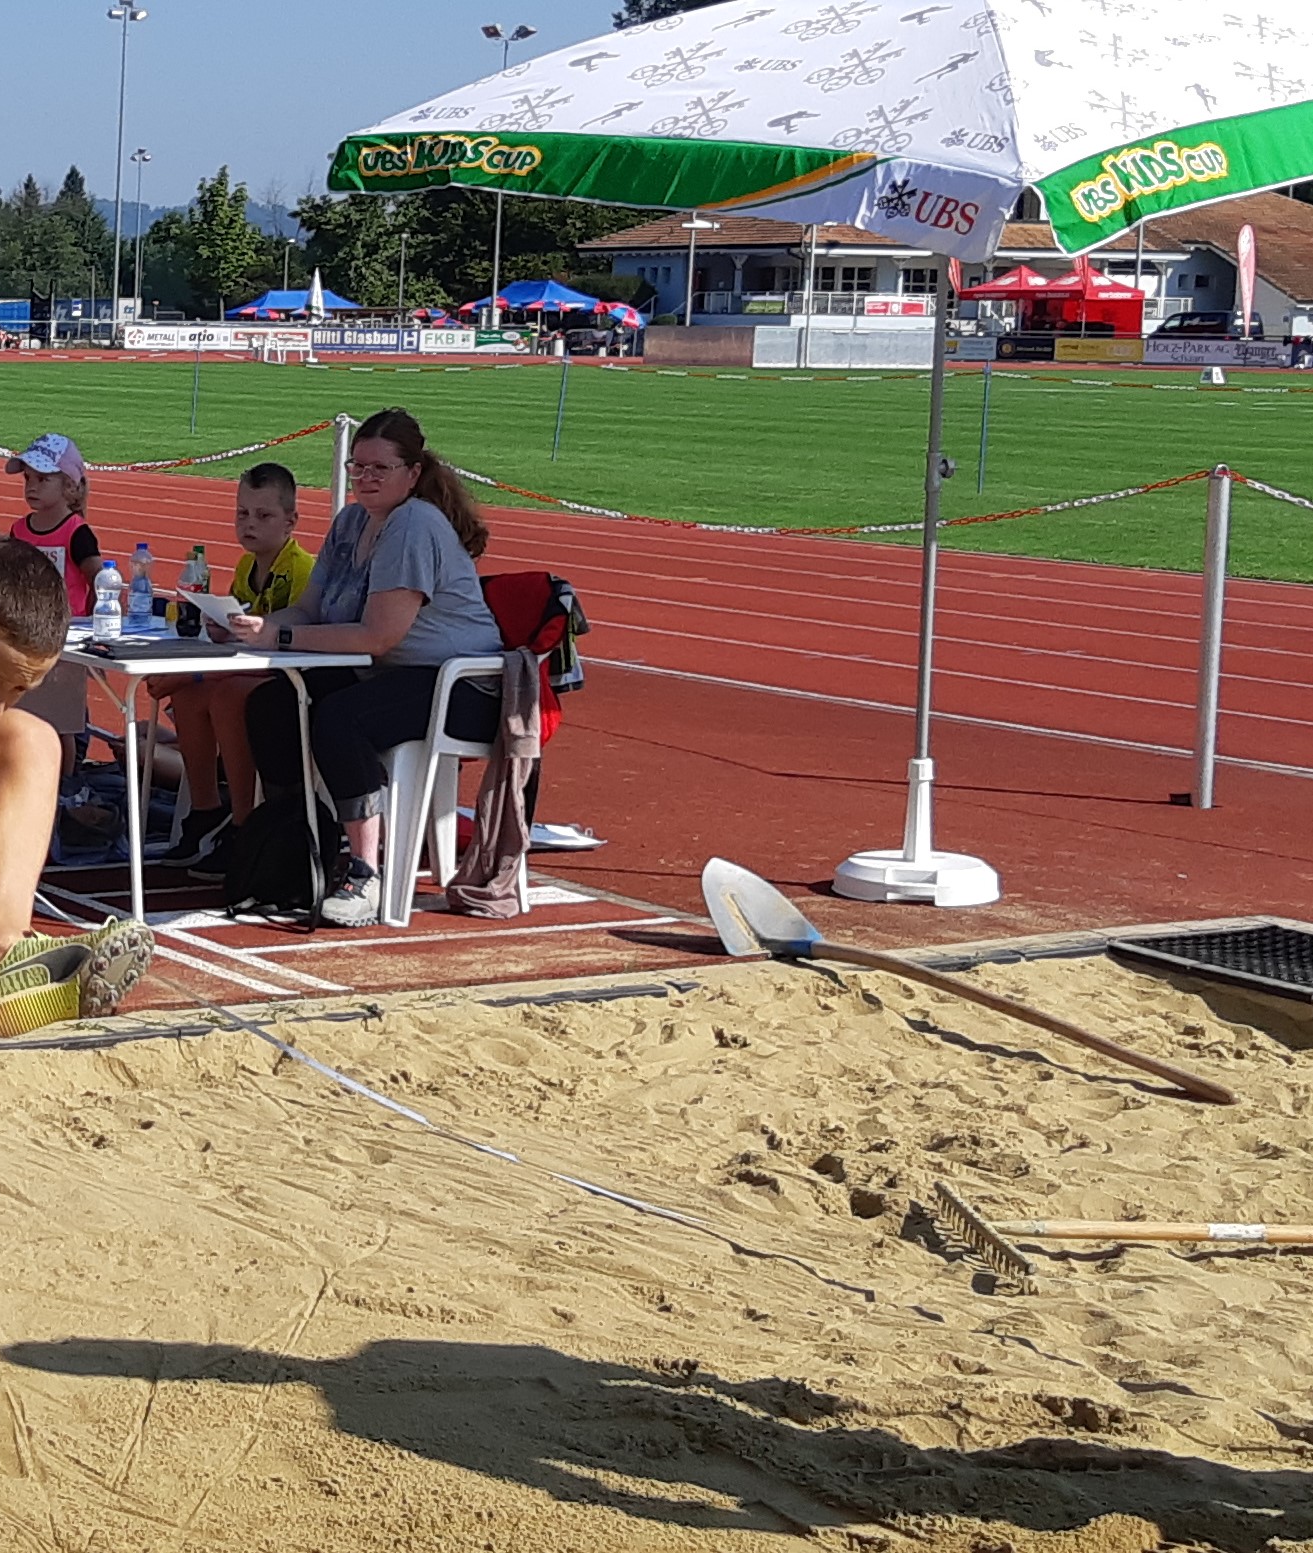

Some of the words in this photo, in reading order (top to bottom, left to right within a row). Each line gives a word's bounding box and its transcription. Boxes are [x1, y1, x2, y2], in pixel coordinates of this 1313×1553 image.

[759, 58, 804, 72] UBS
[432, 105, 476, 121] UBS
[966, 132, 1010, 154] UBS
[1049, 122, 1088, 143] UBS
[363, 148, 409, 173] UBS
[411, 137, 495, 169] KIDS
[485, 148, 537, 171] CUP
[1076, 178, 1119, 216] UBS
[1108, 145, 1186, 194] KIDS
[1184, 147, 1225, 177] CUP
[914, 190, 980, 236] UBS
[424, 332, 456, 345] FKB
